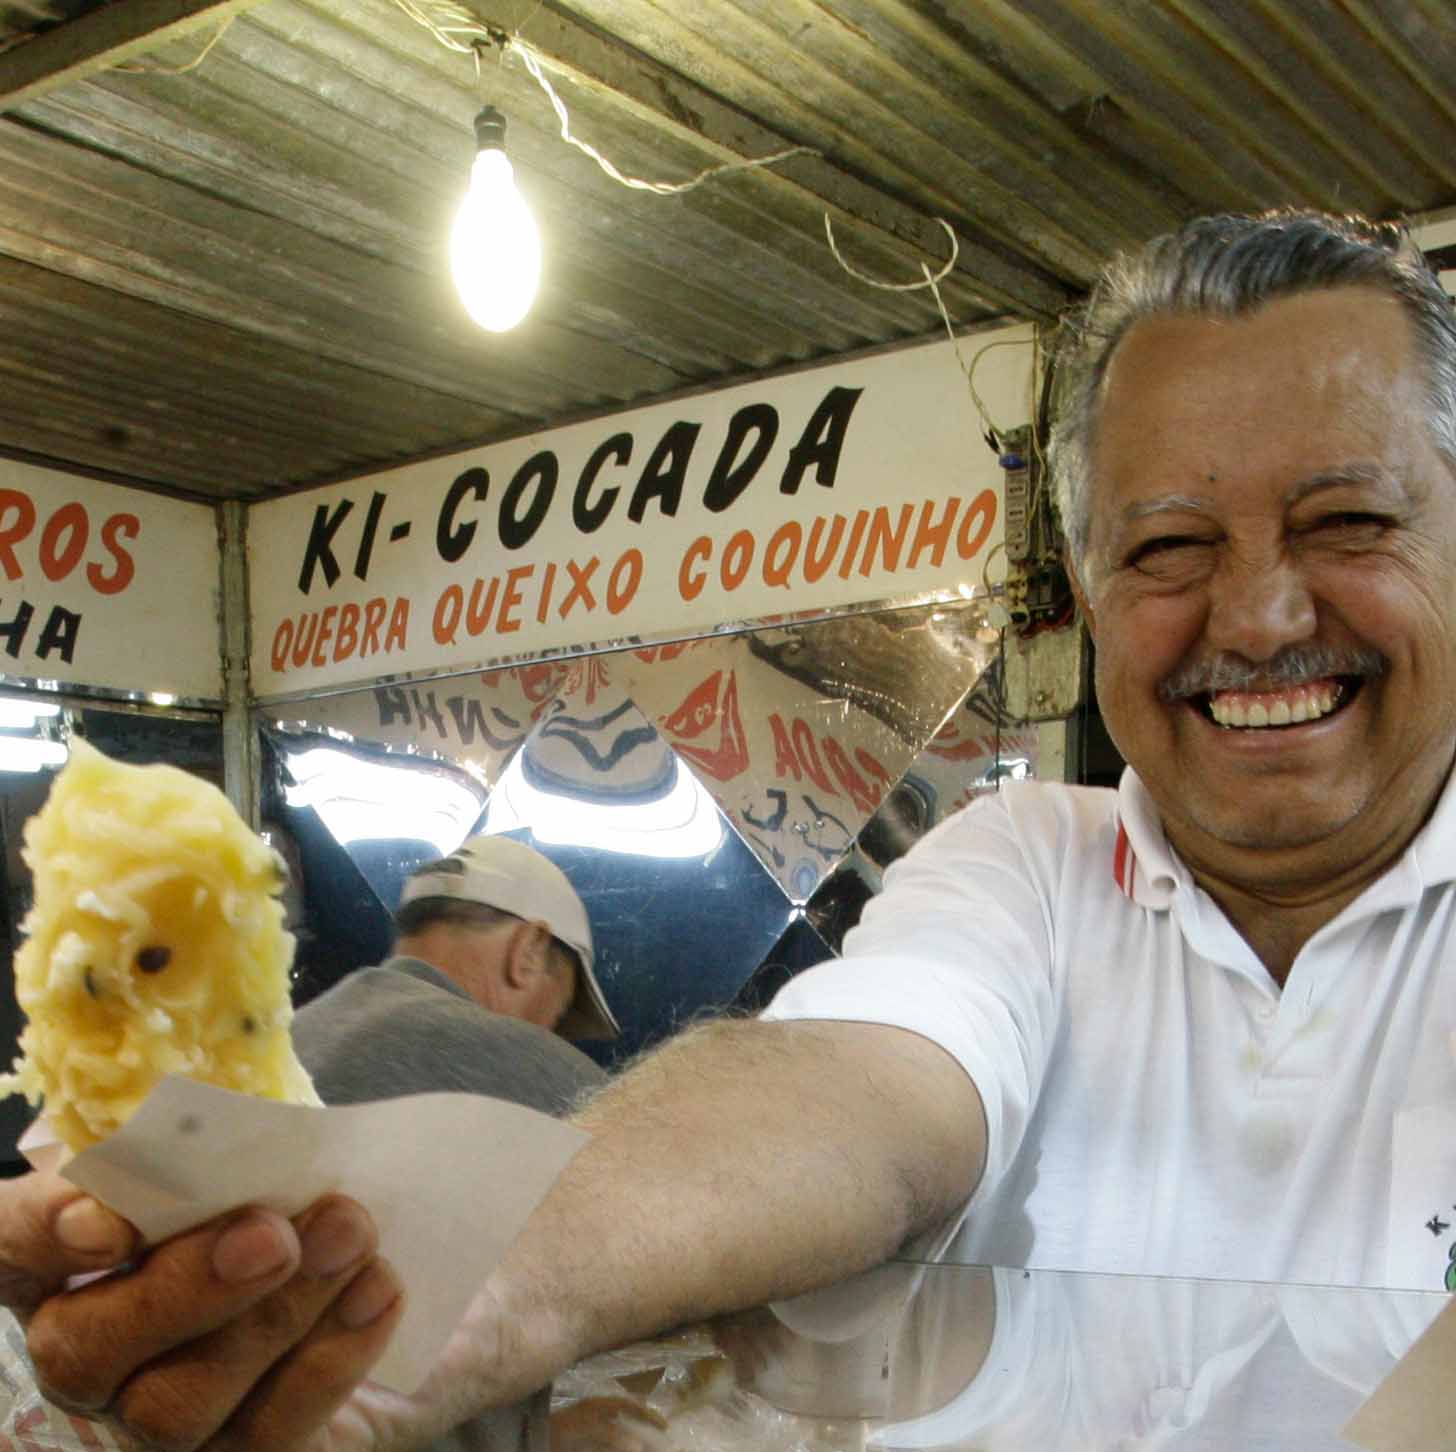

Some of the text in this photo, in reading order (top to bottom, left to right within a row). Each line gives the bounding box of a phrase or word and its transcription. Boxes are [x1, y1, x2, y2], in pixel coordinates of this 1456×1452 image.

[269, 488, 998, 673] QUEBRA QUEIXO COQUINHO
[297, 386, 863, 595] KI-COCADA
